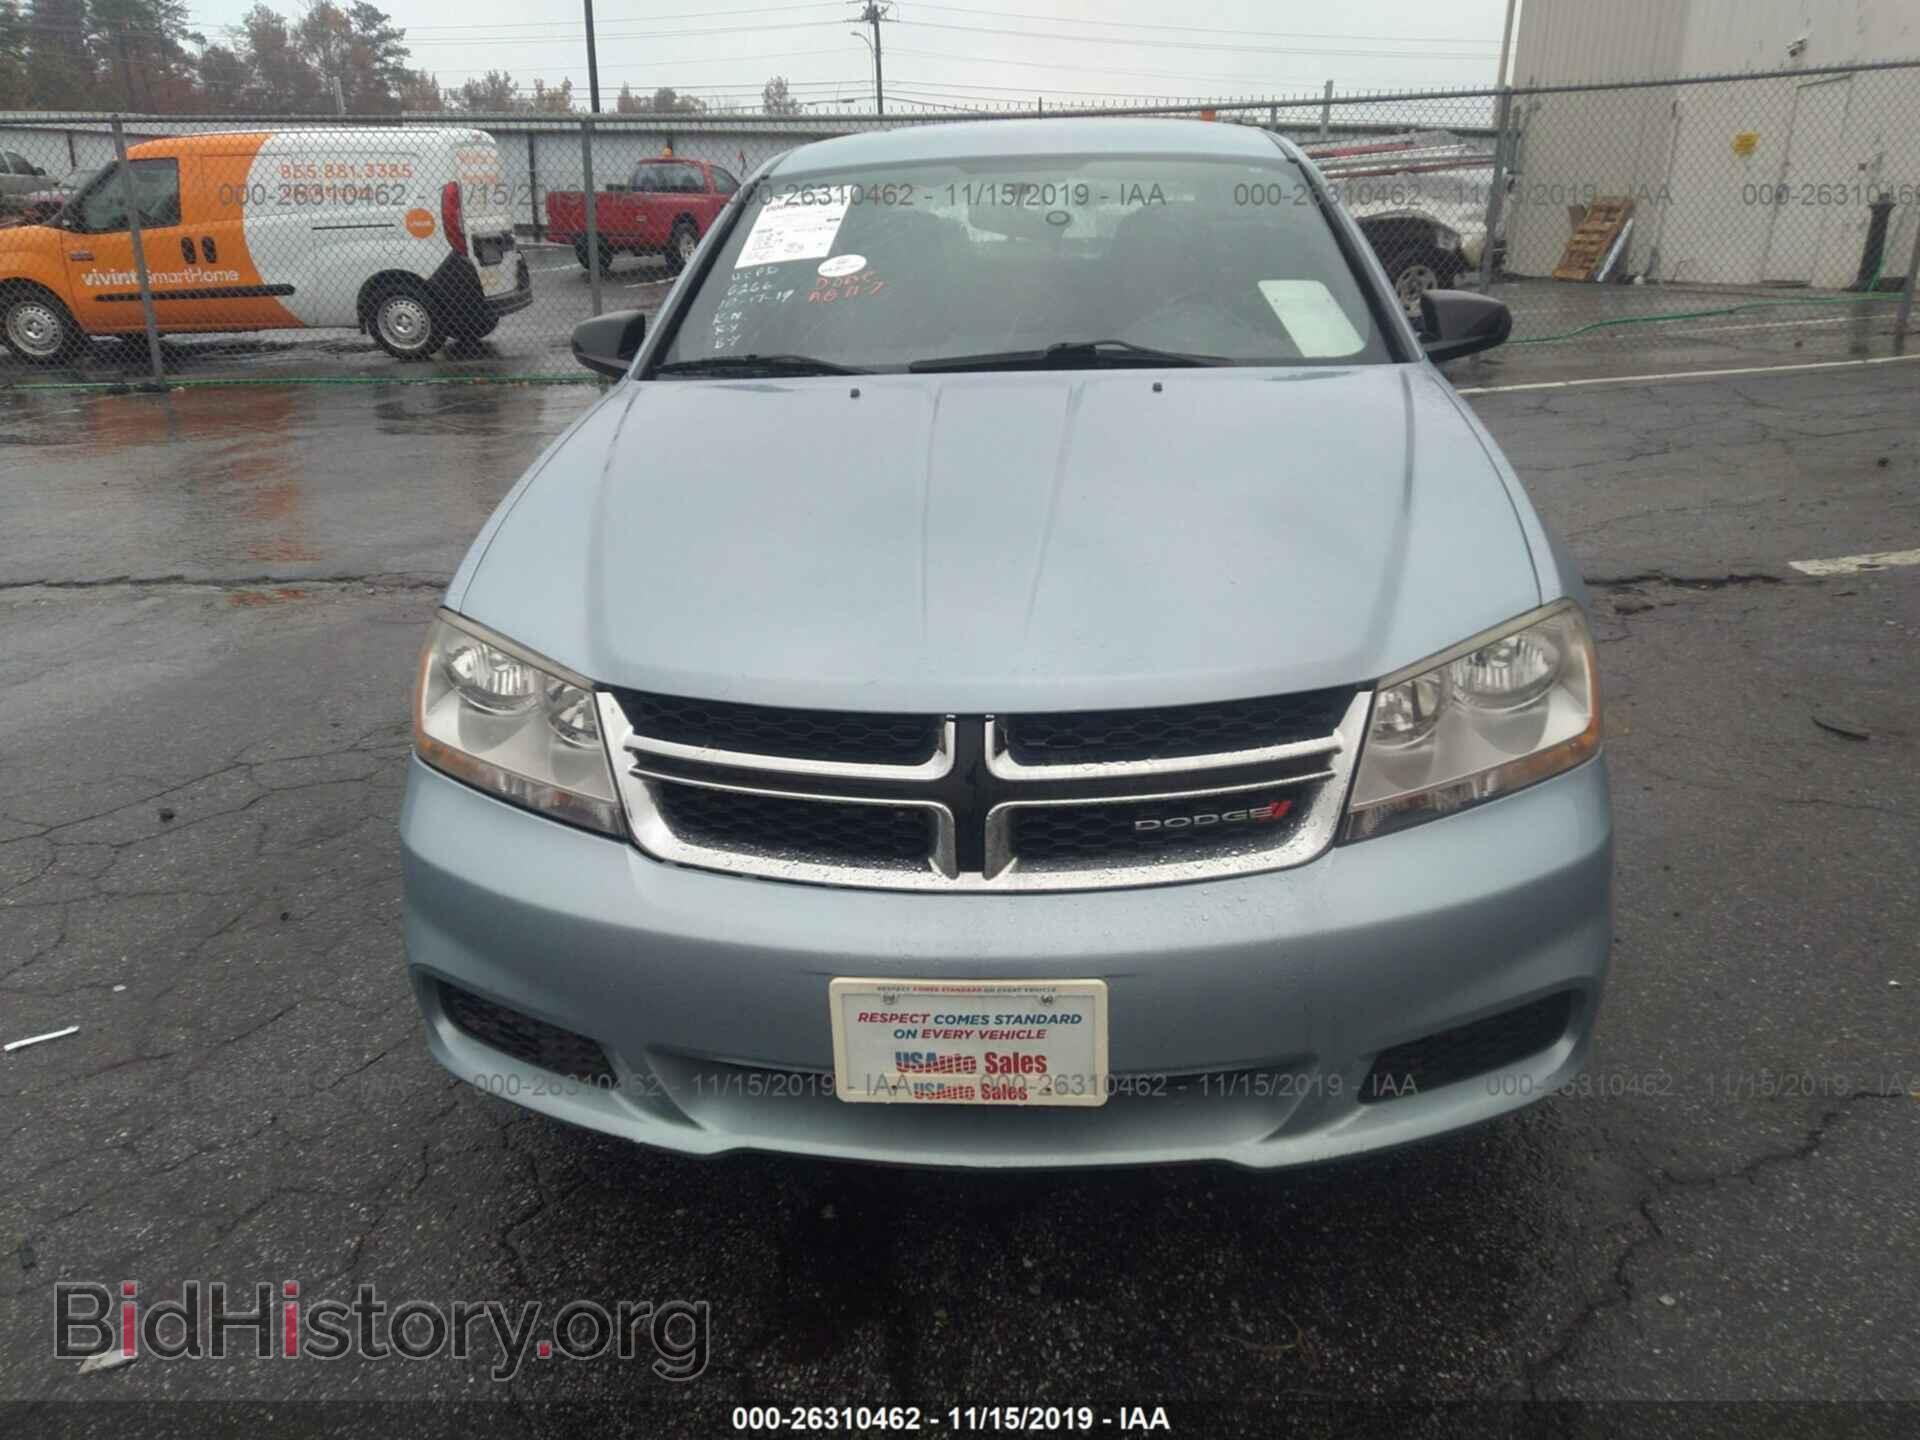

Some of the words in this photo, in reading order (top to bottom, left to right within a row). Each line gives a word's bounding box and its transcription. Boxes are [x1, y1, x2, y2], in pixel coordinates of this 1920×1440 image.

[1134, 805, 1273, 831] DODGE
[857, 1012, 930, 1025] RESPECT
[933, 1013, 989, 1025] COMES
[994, 1013, 1082, 1026] STANDARD
[893, 1028, 917, 1040] ON
[921, 1028, 974, 1040] EVERY
[978, 1029, 1048, 1040] VEHICLE
[895, 1051, 977, 1074] USAuto
[984, 1051, 1048, 1074] Sales
[912, 1082, 976, 1101] USAuto
[980, 1082, 1029, 1101] Sales
